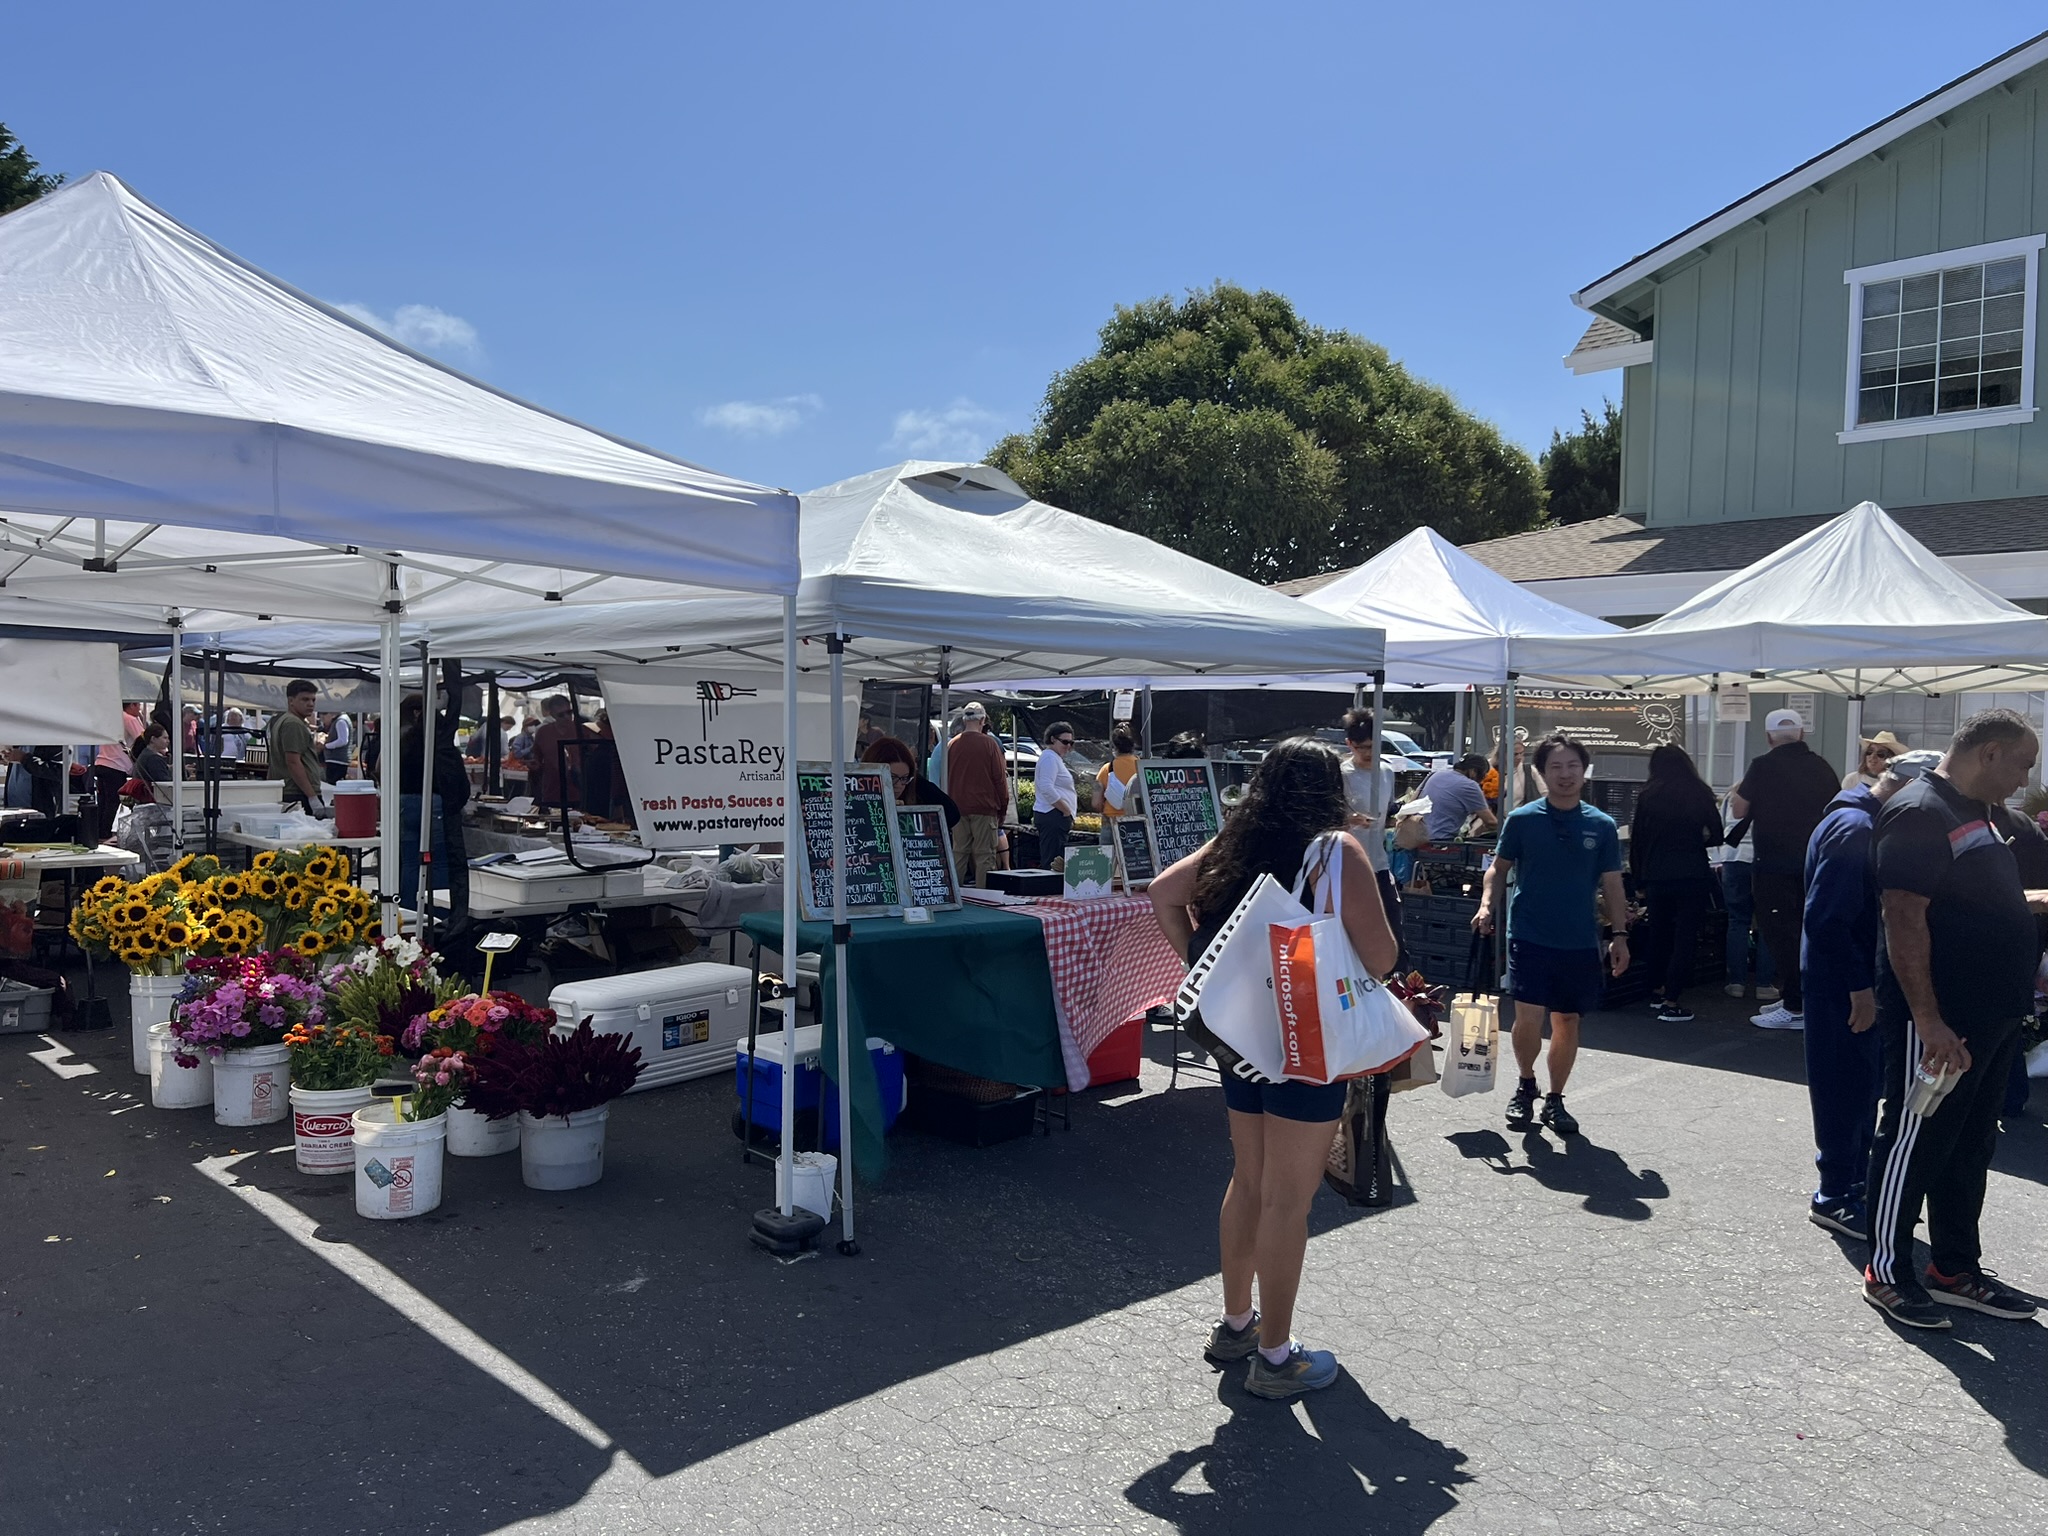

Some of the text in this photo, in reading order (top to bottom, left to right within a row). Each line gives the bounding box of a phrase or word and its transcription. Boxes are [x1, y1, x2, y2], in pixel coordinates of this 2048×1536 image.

[1482, 686, 1555, 699] SIMS
[654, 738, 785, 773] PastaRey
[800, 775, 882, 793] FRES PASTA
[1145, 768, 1204, 785] RAVIOLI
[640, 795, 677, 811] resh
[727, 794, 774, 809] Sauces
[899, 813, 938, 834] SAUCE
[1154, 810, 1196, 826] PEPPADEW
[1156, 823, 1173, 837] BEET
[1158, 837, 1176, 849] FOUR
[1176, 834, 1199, 847] CHEESE
[815, 879, 833, 888] SPIN
[816, 887, 833, 898] BLAC
[883, 892, 897, 904] $10
[1278, 943, 1301, 1068] microsoft.com
[306, 1121, 346, 1131] WESTCO
